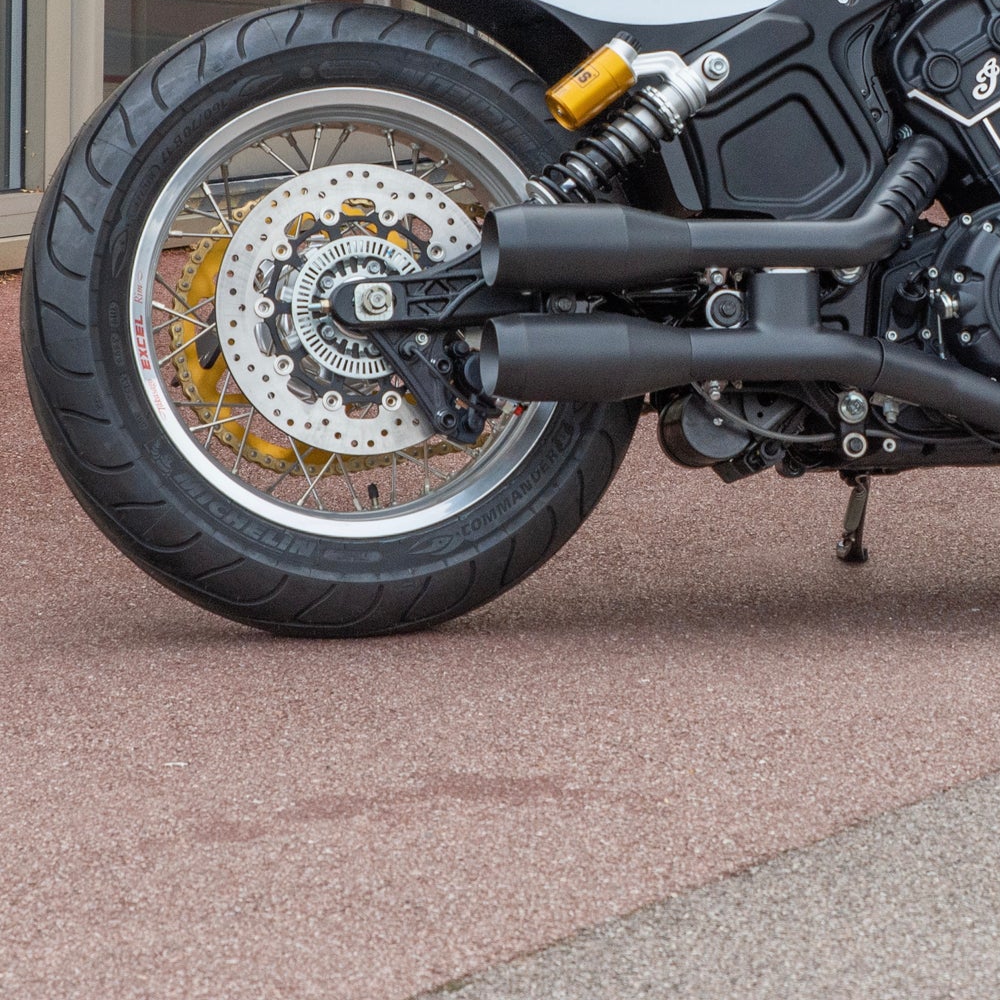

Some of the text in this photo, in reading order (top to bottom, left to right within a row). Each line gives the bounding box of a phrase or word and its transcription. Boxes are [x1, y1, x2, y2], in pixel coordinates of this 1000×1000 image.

[134, 314, 151, 371] EXCEL
[171, 468, 319, 558] MICHELIN
[461, 451, 559, 537] COMMANDER
